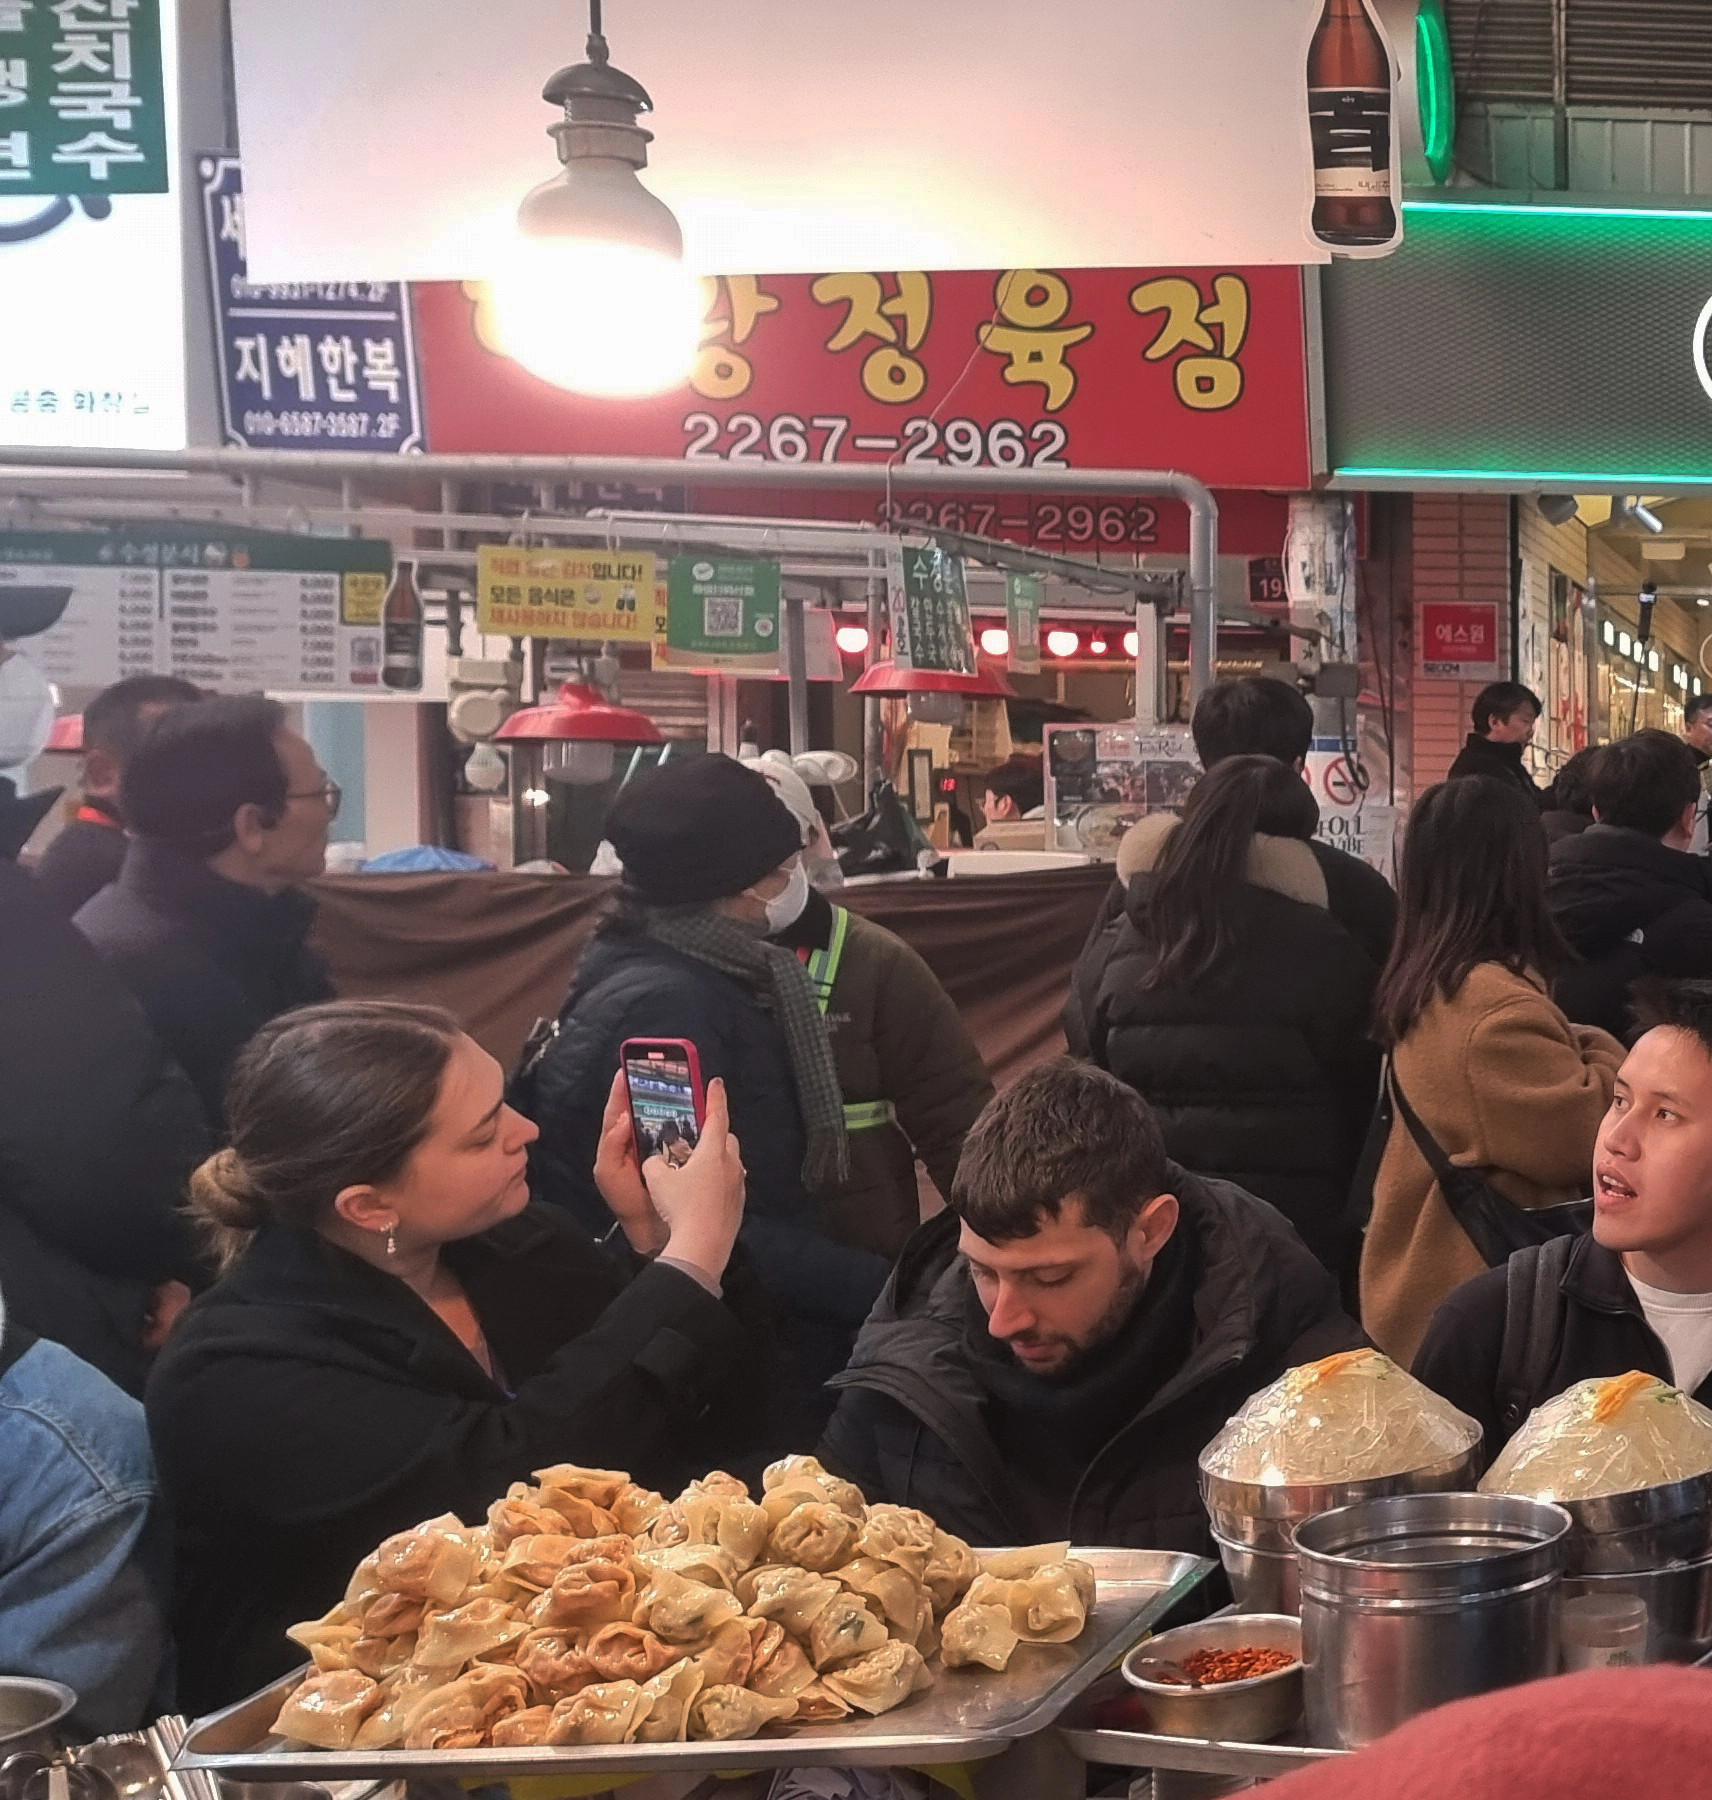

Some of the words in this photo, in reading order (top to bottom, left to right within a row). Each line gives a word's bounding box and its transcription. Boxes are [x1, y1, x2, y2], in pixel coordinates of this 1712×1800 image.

[234, 333, 400, 403] 지혜한복
[683, 411, 1067, 471] 2267-2962
[1435, 623, 1485, 645] 에스원
[1313, 815, 1367, 838] EOUL
